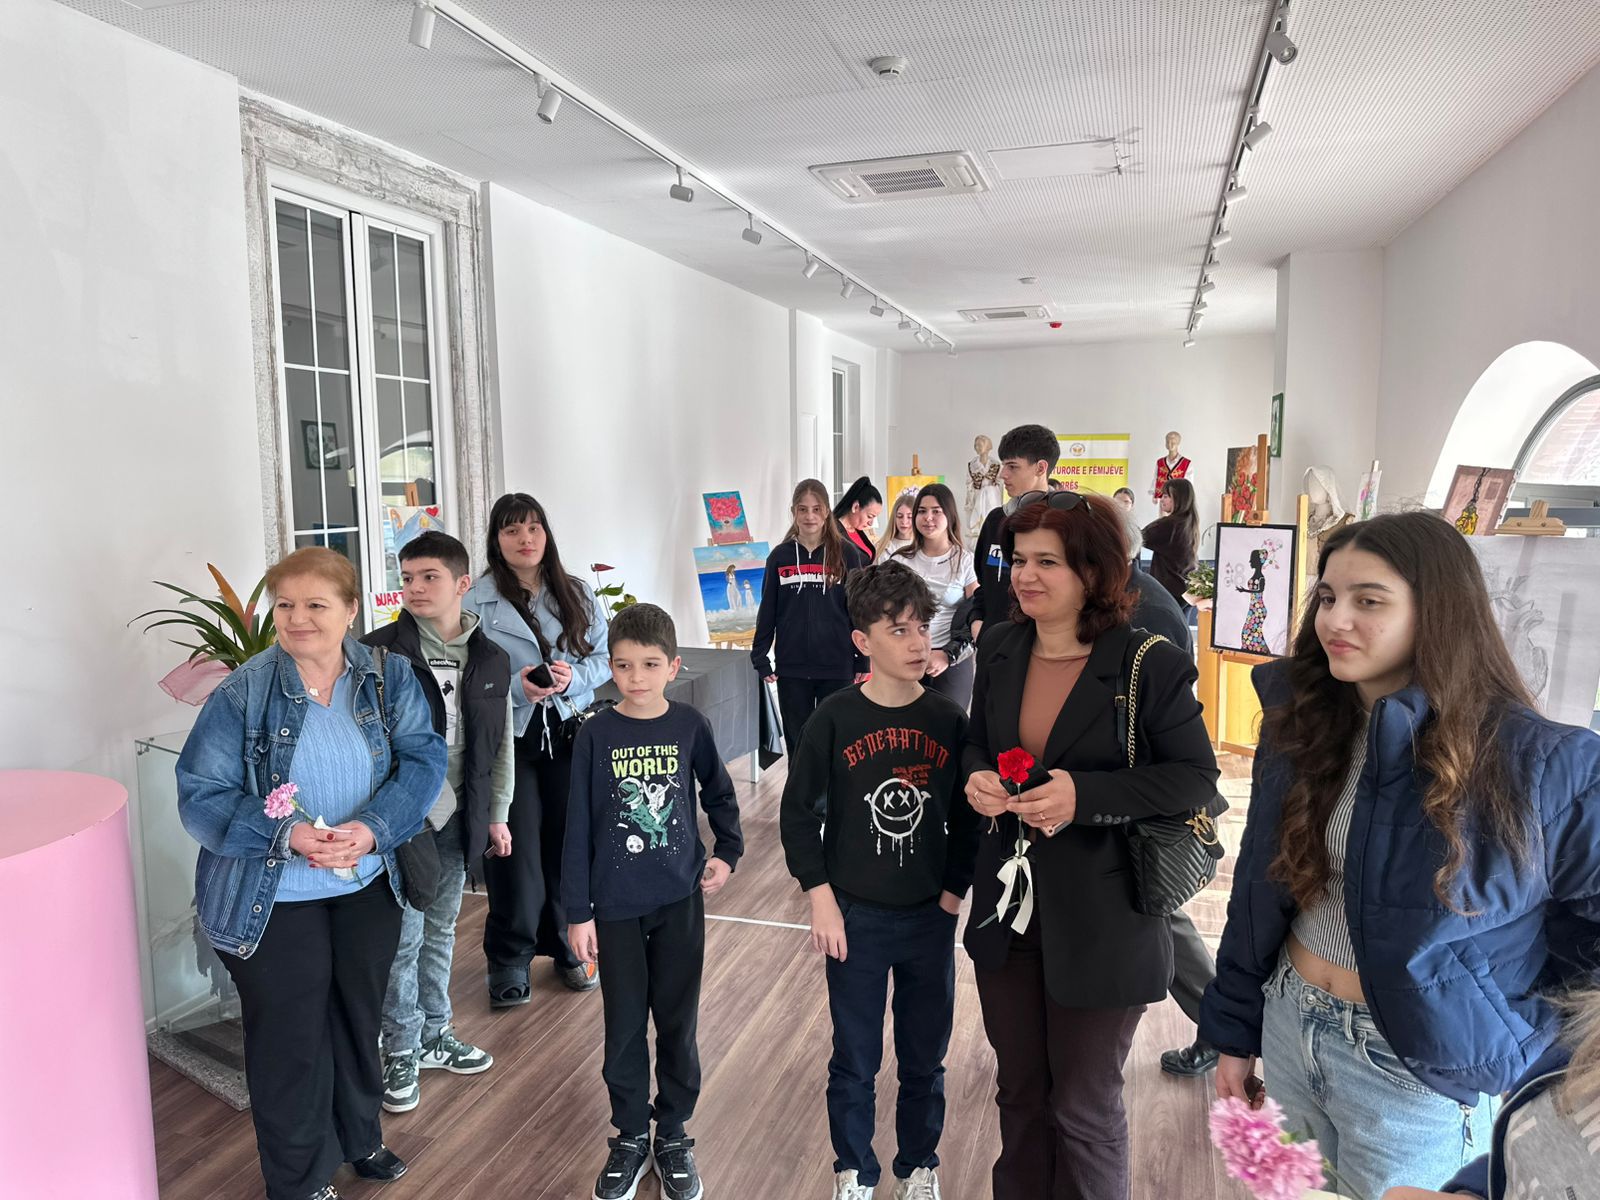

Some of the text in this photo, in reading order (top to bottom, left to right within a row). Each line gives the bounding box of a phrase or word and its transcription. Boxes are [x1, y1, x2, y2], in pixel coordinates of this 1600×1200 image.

[1082, 466, 1087, 475] E
[611, 745, 679, 760] OUT OF THIS
[842, 727, 950, 769] GENERATION
[611, 757, 679, 778] WORLD
